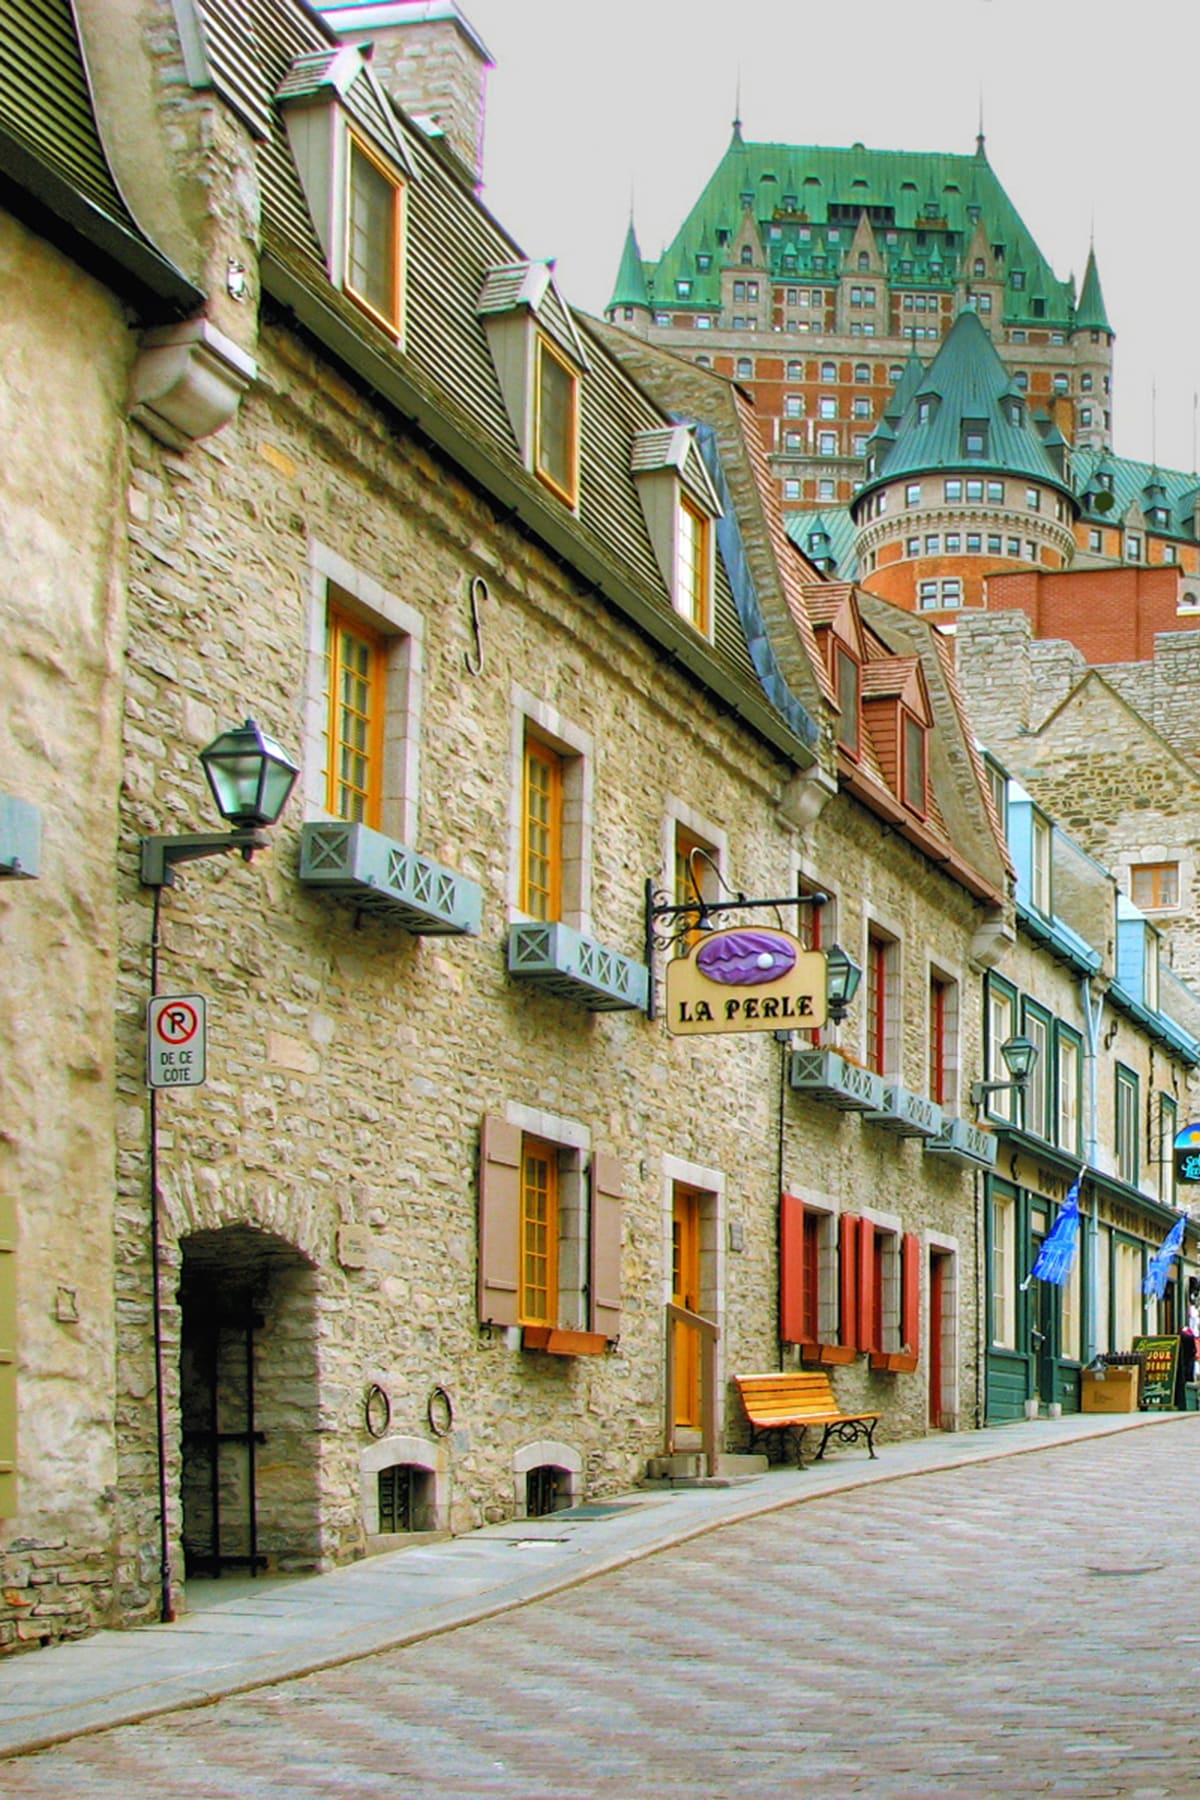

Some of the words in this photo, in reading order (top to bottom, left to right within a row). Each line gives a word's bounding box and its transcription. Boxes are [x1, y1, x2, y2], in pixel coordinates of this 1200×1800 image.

[680, 1001, 714, 1023] LA
[726, 995, 815, 1021] PERLE
[160, 1052, 175, 1066] DE
[179, 1050, 193, 1065] CE
[1146, 1351, 1172, 1360] JOUX
